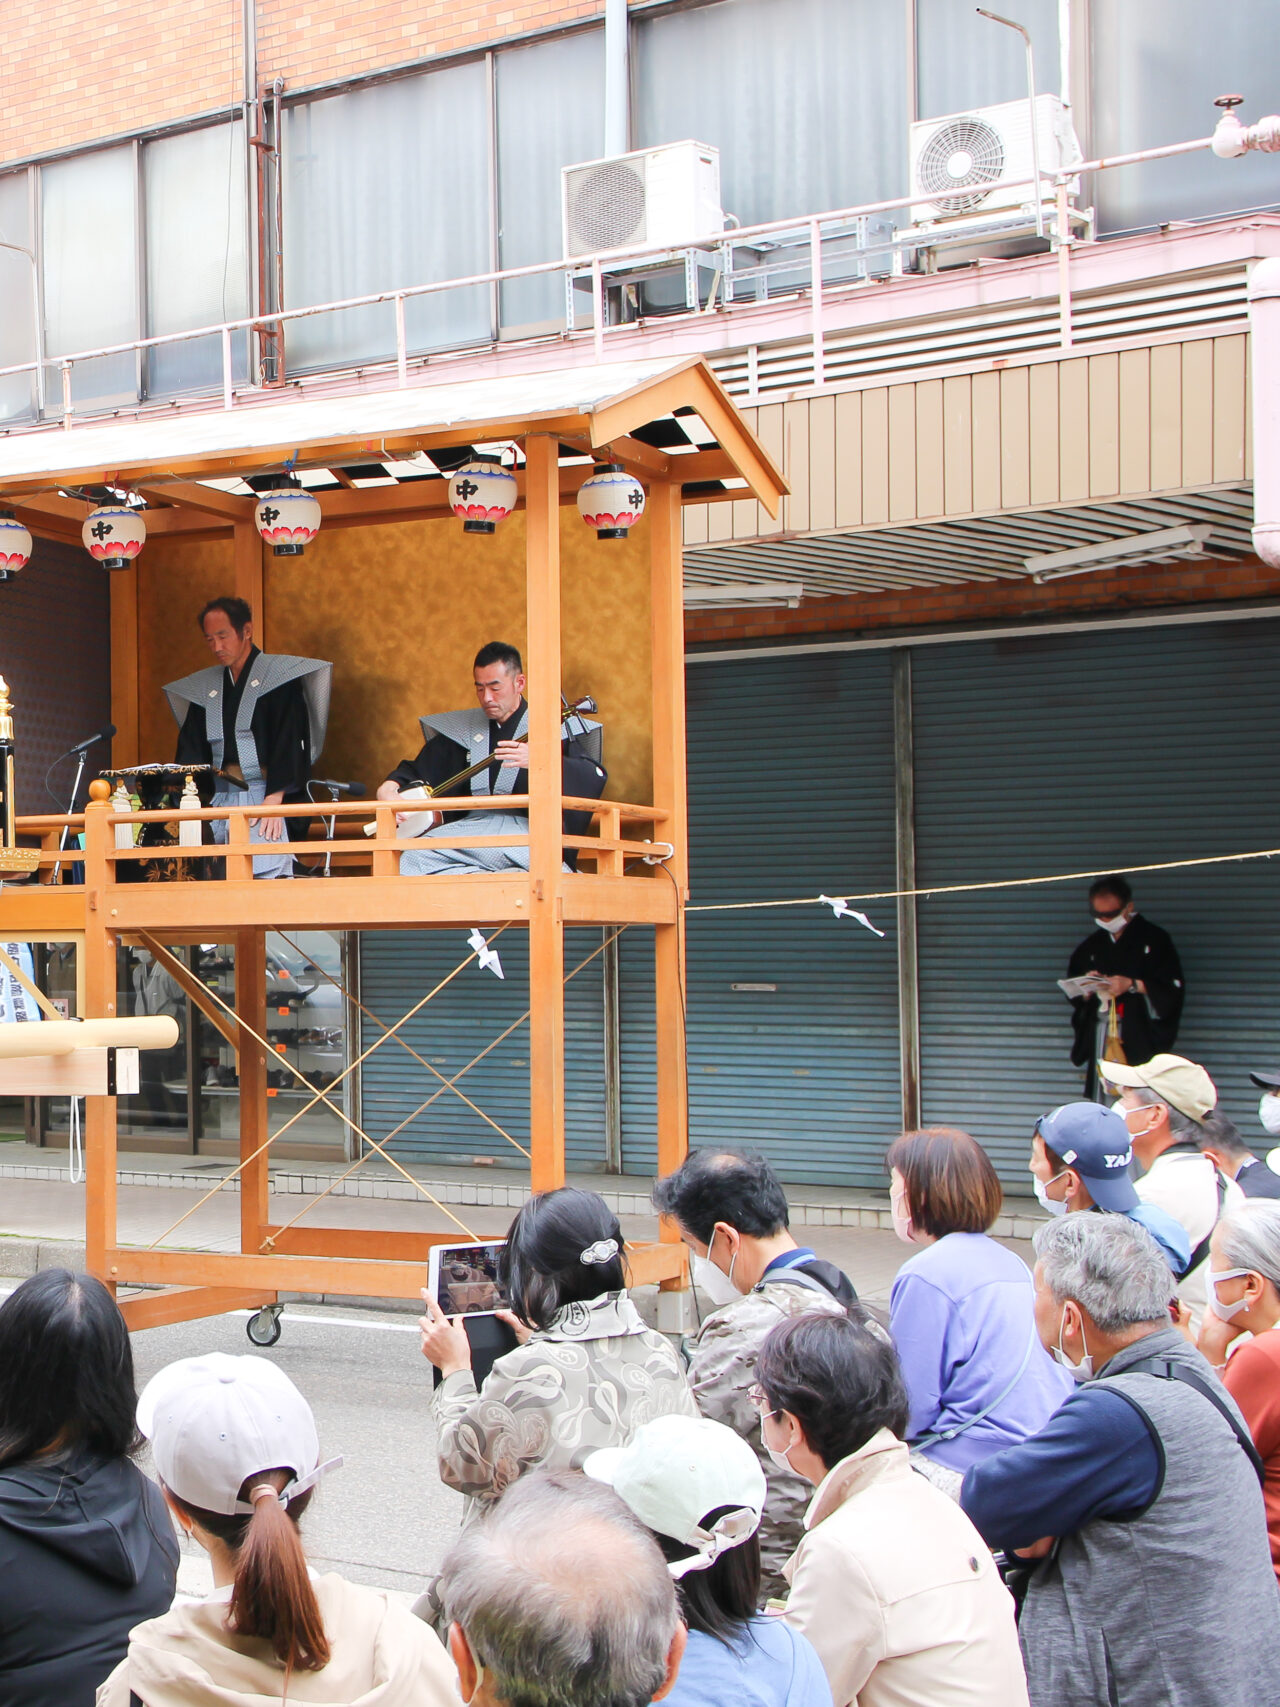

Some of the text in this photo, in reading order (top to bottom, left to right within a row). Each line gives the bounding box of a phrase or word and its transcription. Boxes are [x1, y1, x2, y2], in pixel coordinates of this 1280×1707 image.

[456, 479, 478, 501] 中
[629, 489, 644, 509] 中
[260, 506, 280, 526] 中
[91, 521, 113, 540] 中
